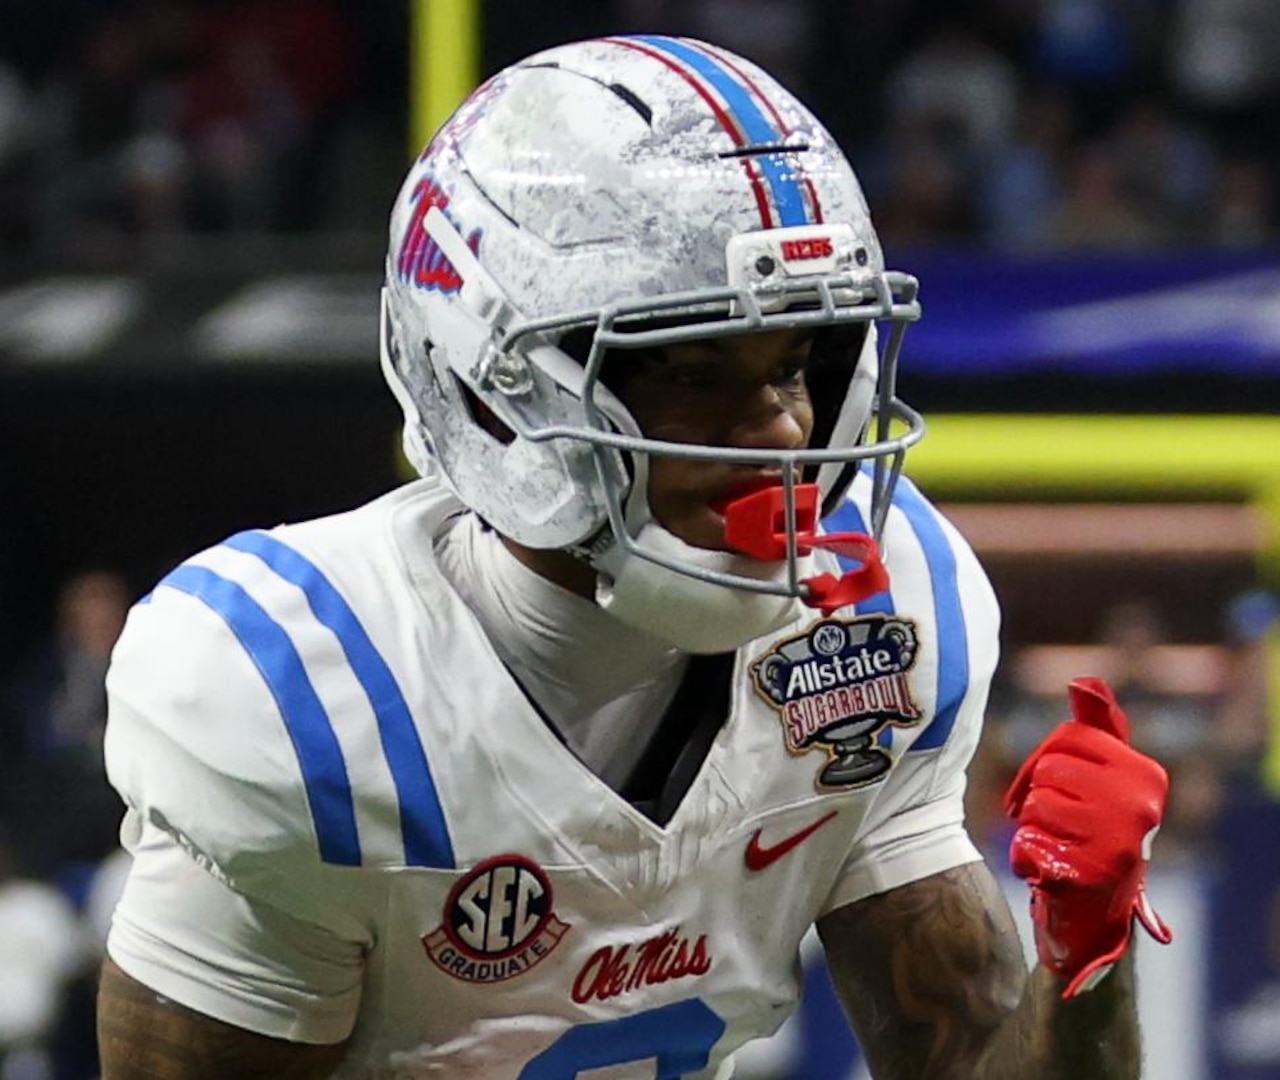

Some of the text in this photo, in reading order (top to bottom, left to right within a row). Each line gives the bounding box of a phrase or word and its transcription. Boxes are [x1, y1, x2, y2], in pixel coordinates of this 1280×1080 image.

[786, 647, 893, 698] Allstate
[456, 866, 545, 953] SEC
[438, 940, 548, 980] GRADUATE
[572, 925, 712, 1005] Ole Miss
